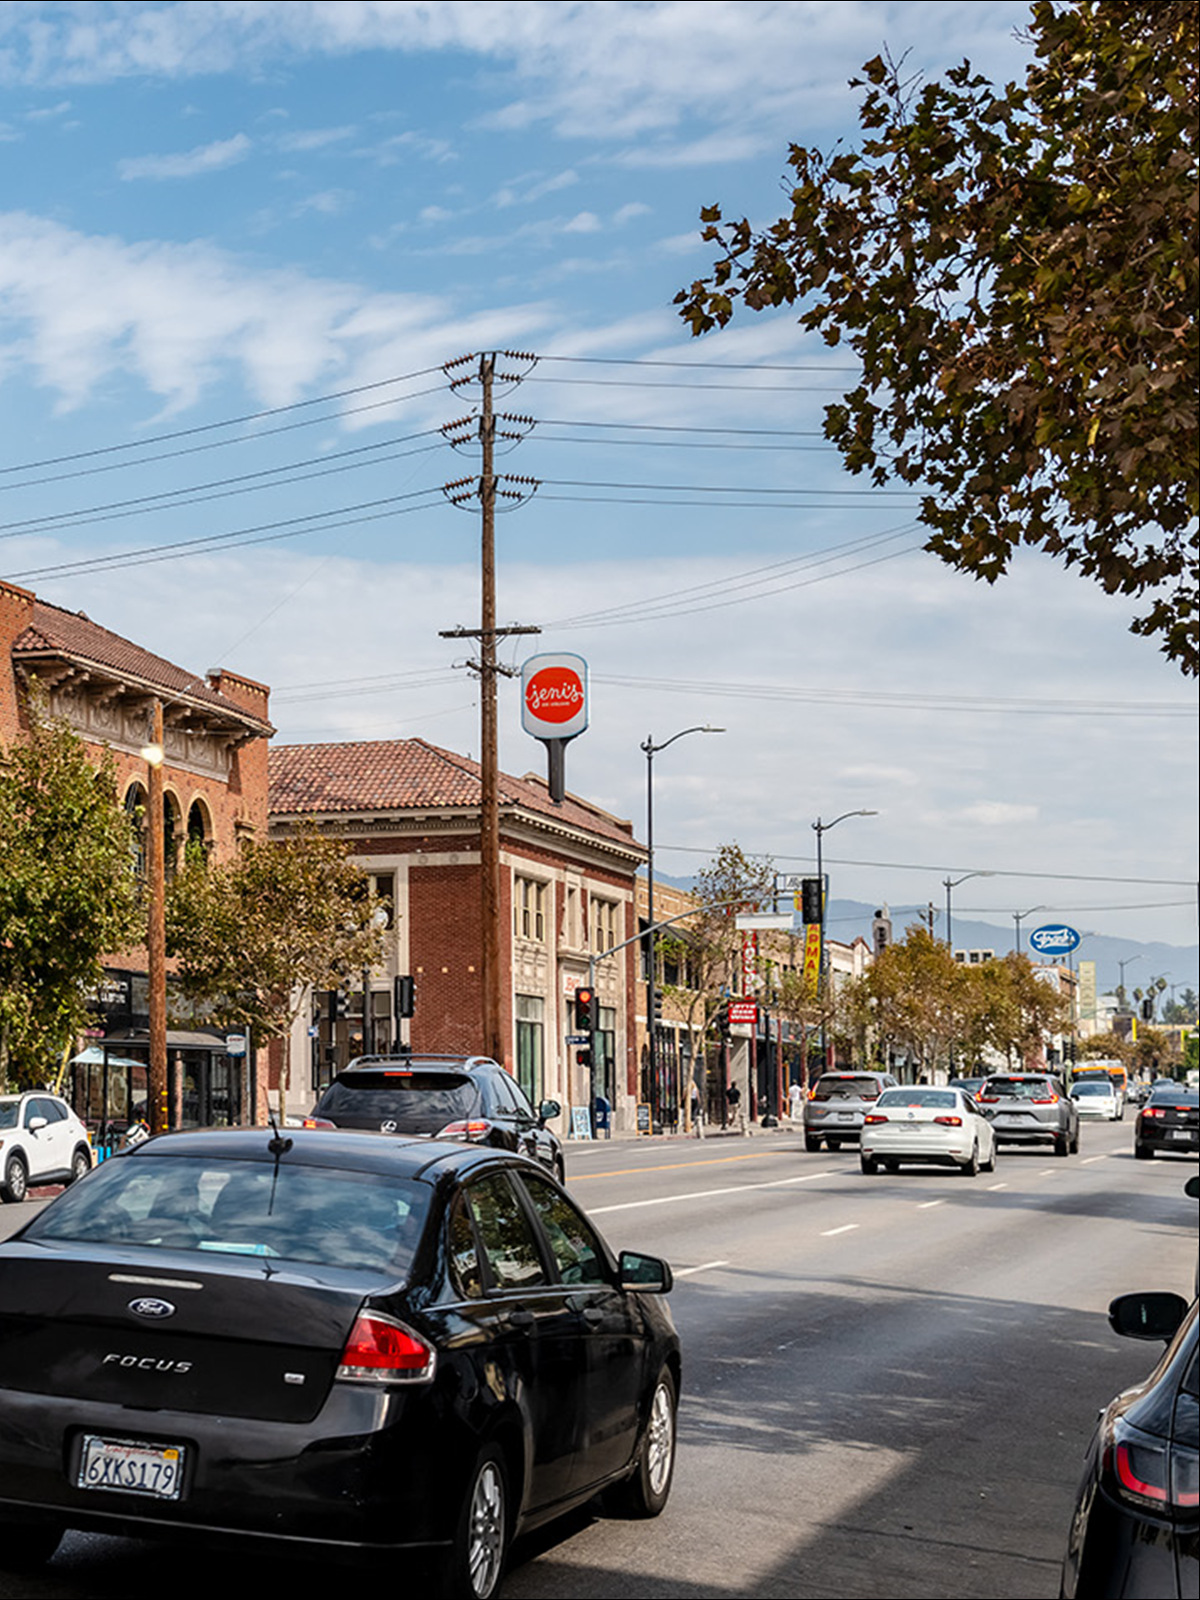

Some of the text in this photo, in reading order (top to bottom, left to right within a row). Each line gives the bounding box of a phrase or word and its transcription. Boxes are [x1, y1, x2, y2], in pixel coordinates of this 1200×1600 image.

[527, 682, 583, 709] jeni's
[136, 1300, 164, 1315] Ford
[102, 1353, 193, 1374] FOCUS
[88, 1456, 174, 1490] 6XKS179
